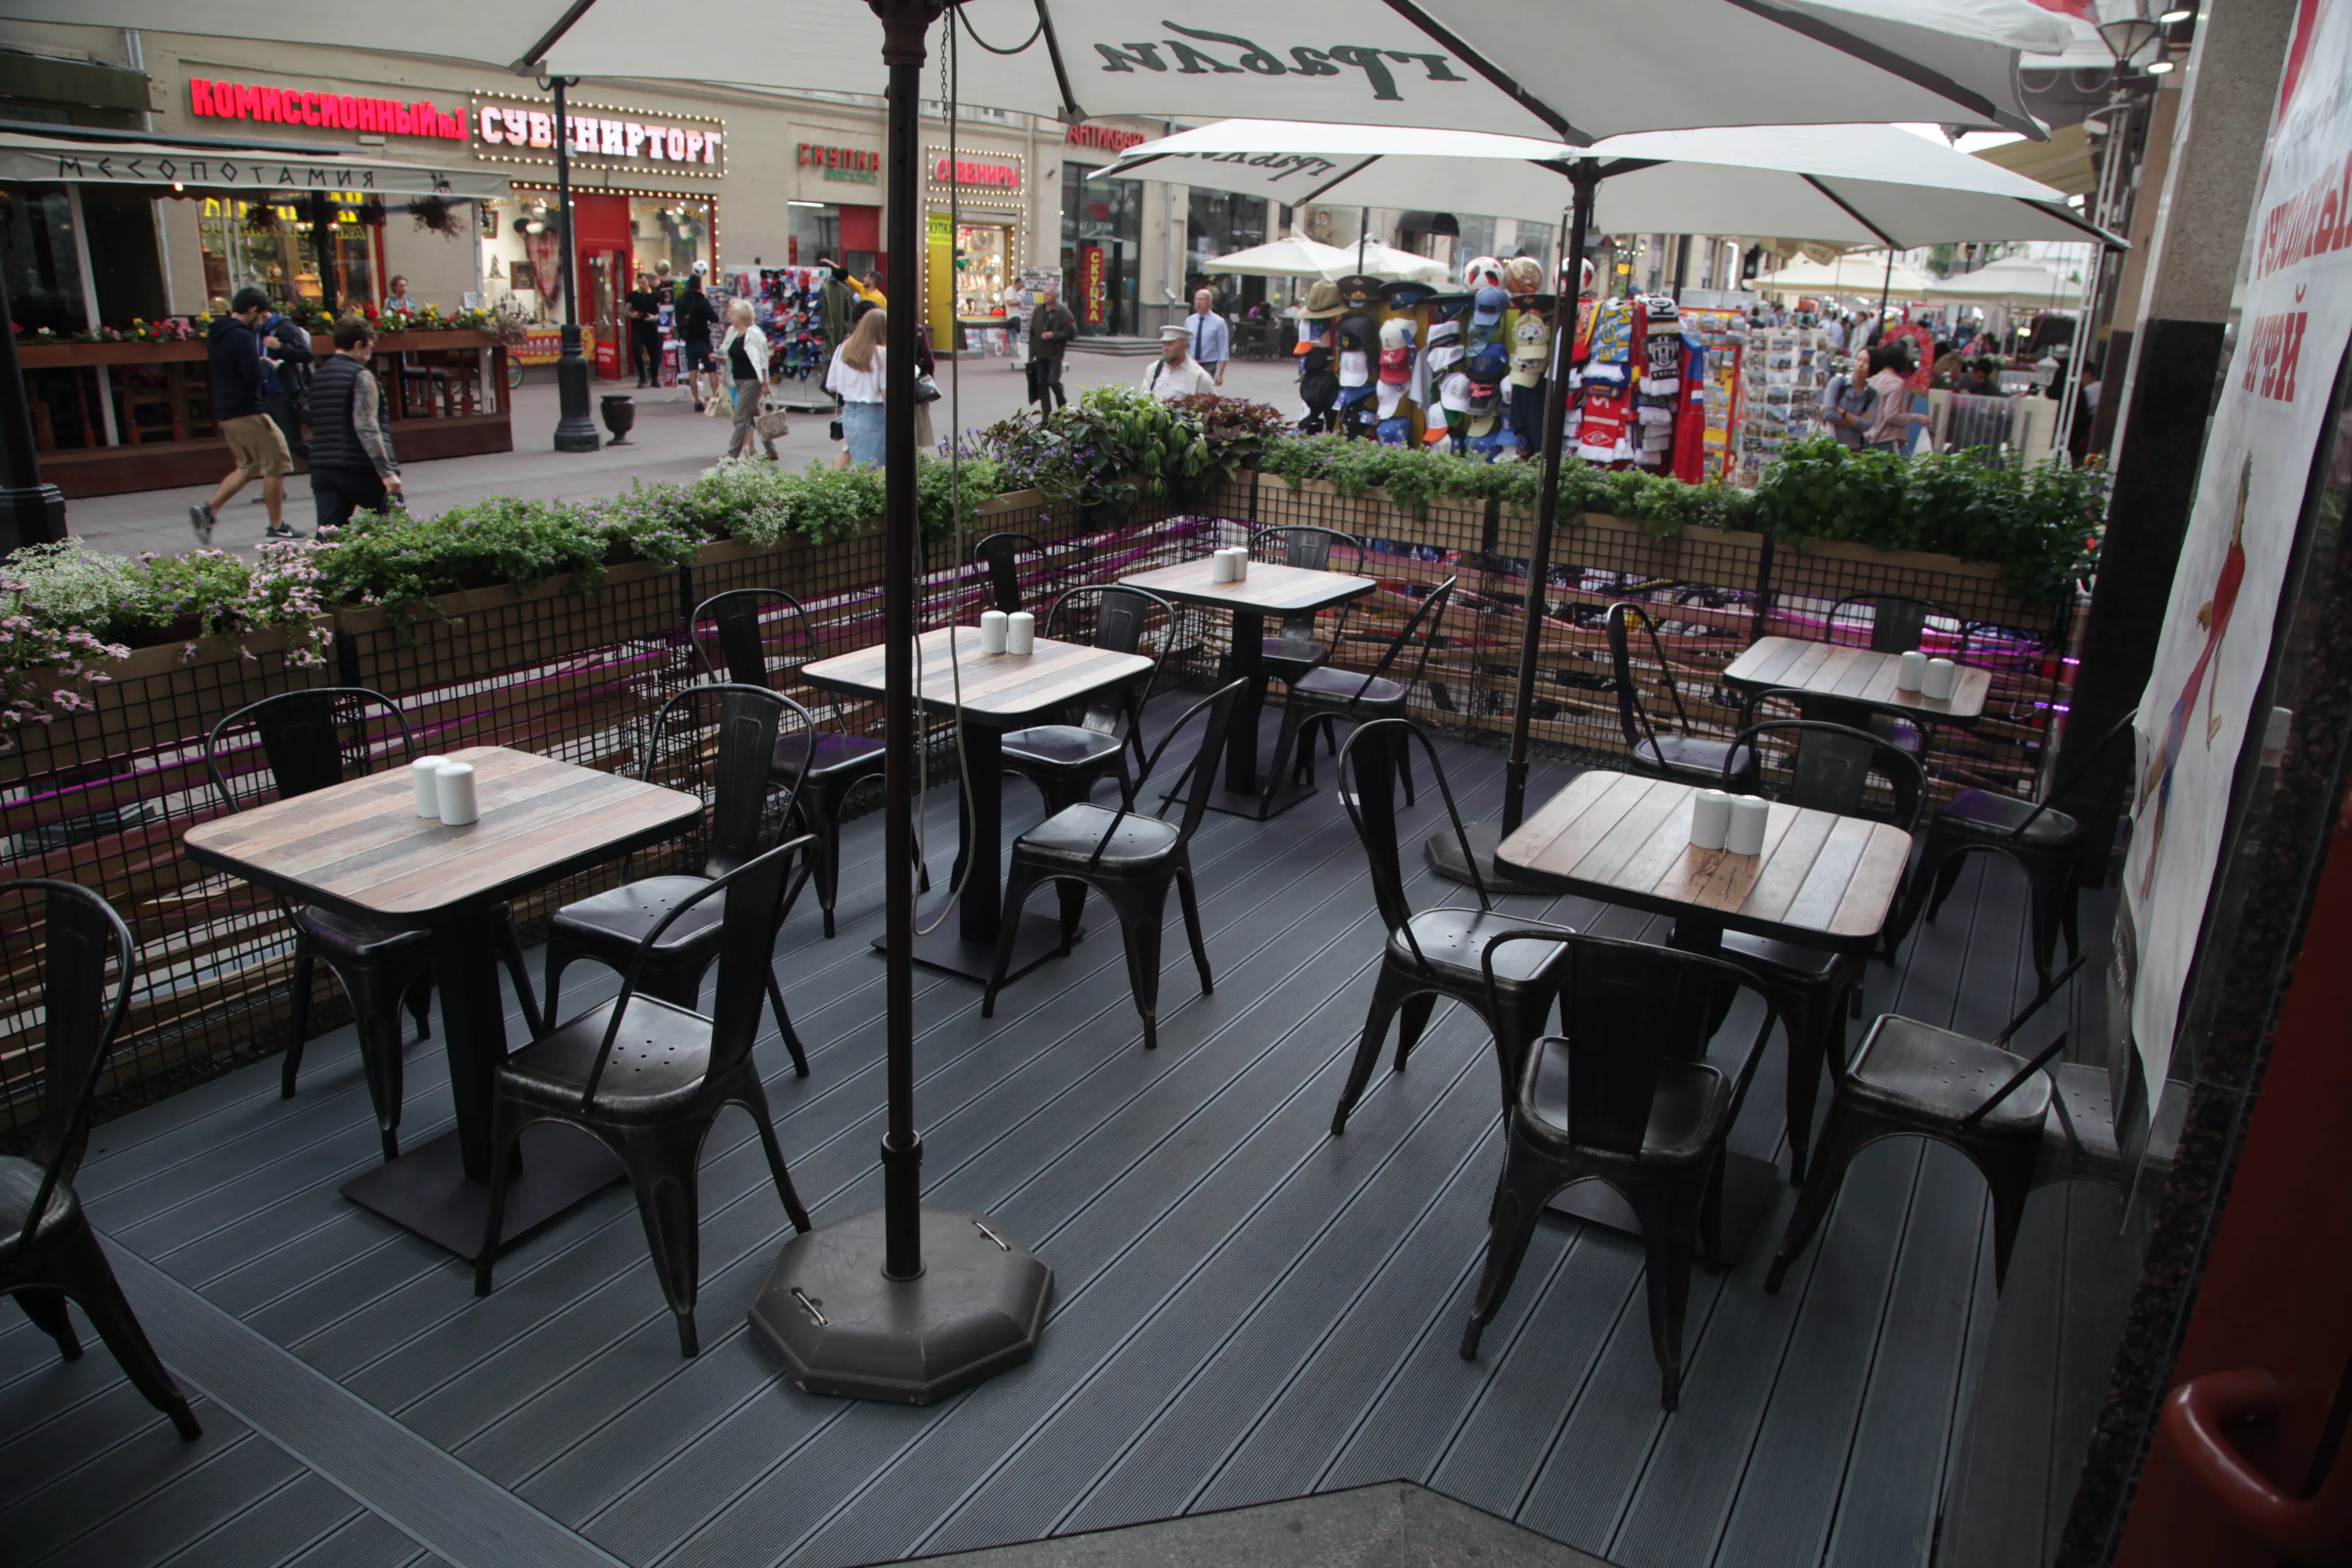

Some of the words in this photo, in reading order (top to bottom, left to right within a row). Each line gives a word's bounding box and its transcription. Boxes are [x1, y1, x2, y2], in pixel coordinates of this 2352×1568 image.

[190, 77, 437, 137] КОМИССИОННЫЙ
[479, 106, 722, 164] СУВЕНИРТОРГ
[59, 155, 374, 189] МЕСОПОТАМИЯ
[798, 142, 880, 171] СКУПКА
[1089, 251, 1100, 321] СКУПКА
